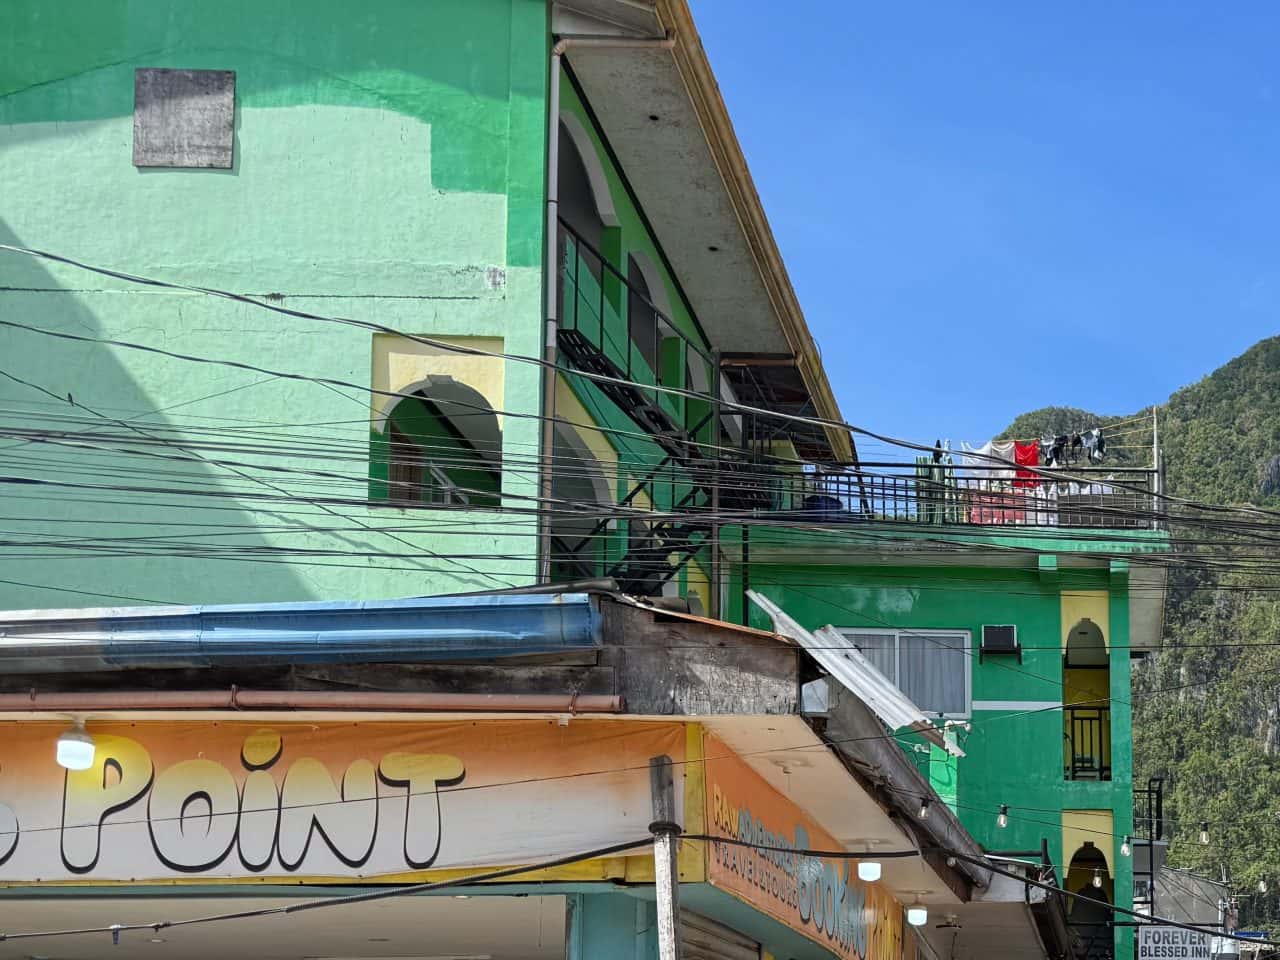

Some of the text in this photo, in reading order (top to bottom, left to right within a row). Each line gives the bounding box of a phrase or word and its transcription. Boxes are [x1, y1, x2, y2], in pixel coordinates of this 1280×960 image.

[1144, 930, 1206, 945] FOREVER
[1141, 945, 1210, 958] BLESSED INN
